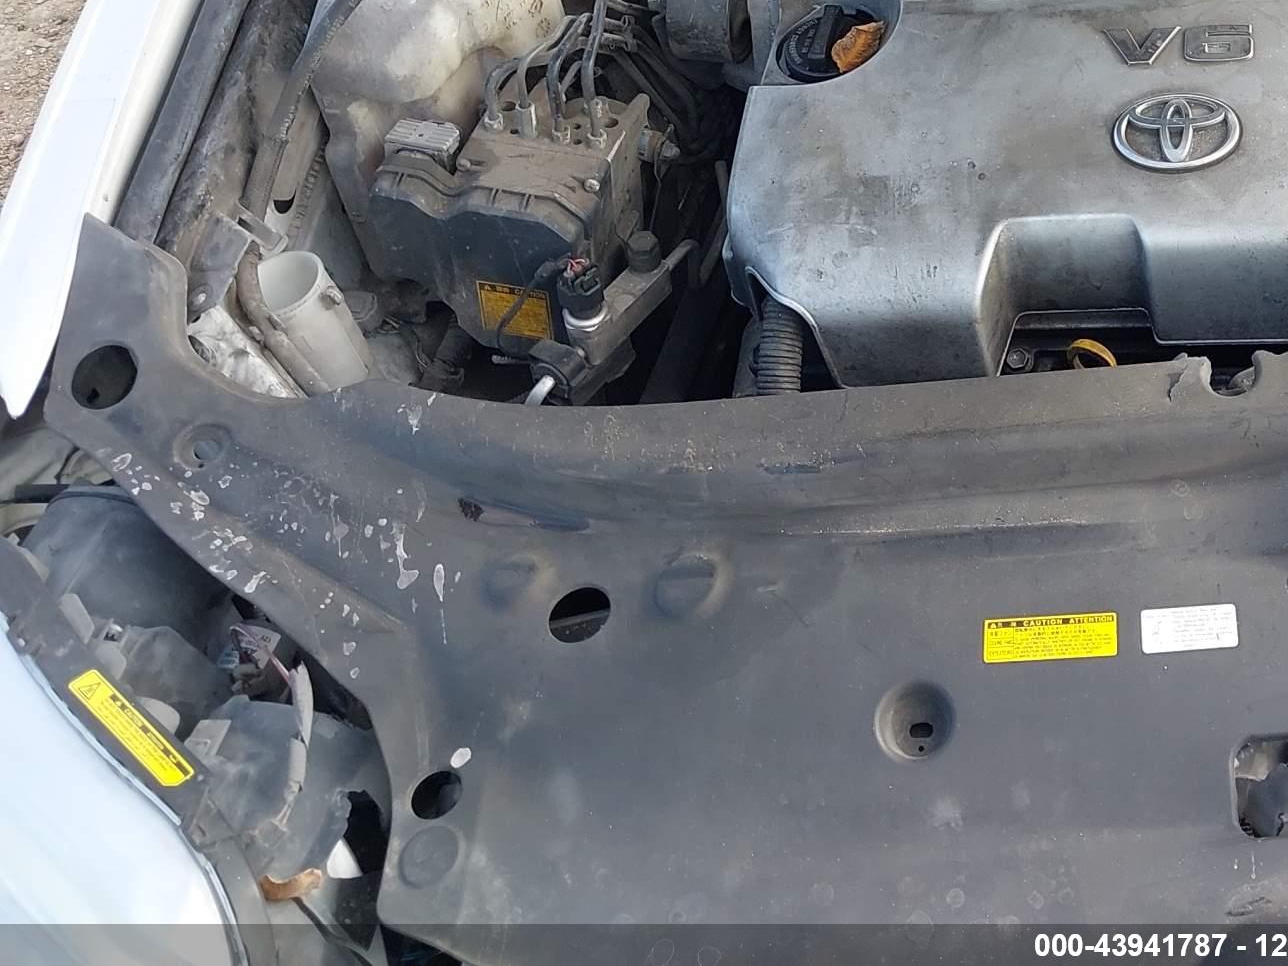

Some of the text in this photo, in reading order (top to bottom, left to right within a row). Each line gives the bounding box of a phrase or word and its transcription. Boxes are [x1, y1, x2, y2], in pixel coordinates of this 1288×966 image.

[1103, 24, 1254, 65] V6
[1022, 618, 1063, 627] CAUTION
[1069, 615, 1113, 624] ATTENTION
